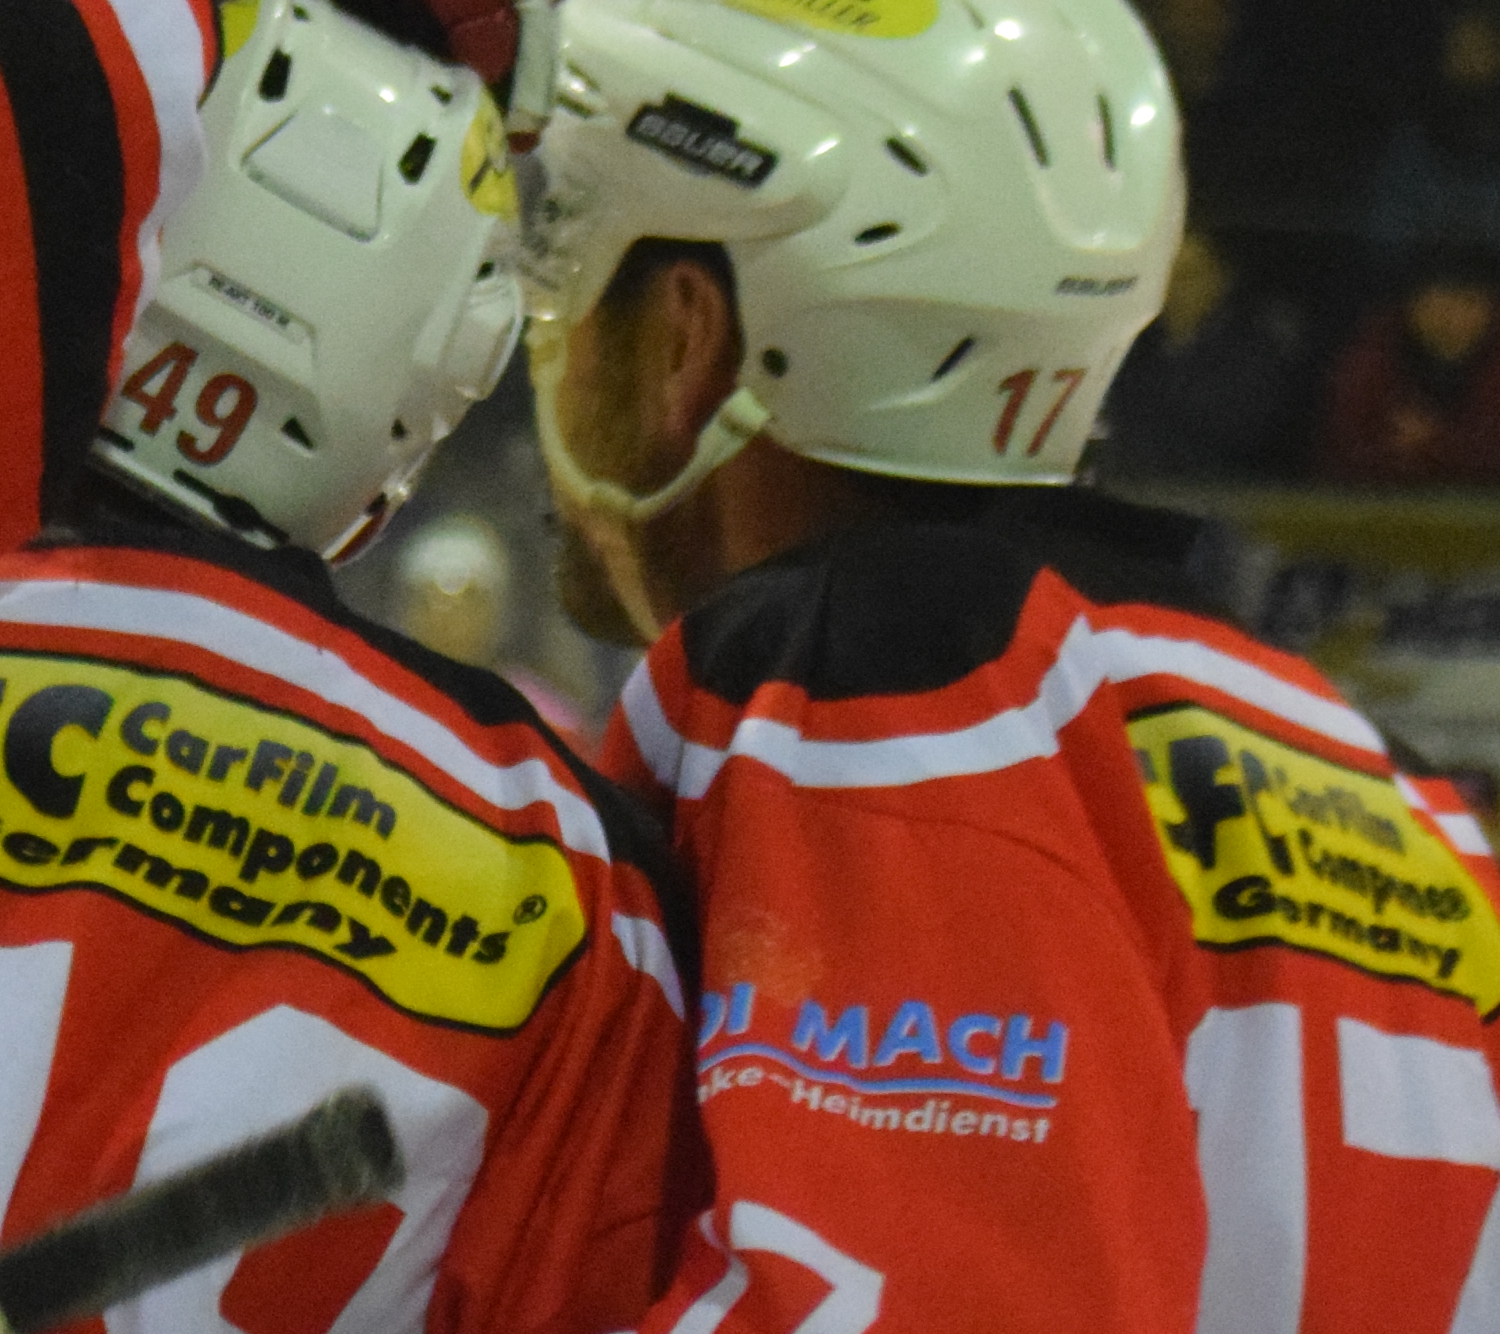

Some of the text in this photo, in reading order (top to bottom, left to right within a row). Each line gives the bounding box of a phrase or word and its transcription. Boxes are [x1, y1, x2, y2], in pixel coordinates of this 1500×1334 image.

[121, 340, 258, 465] 49
[991, 367, 1088, 459] 17
[116, 699, 398, 841] CarFilm
[791, 997, 1070, 1086] MACH
